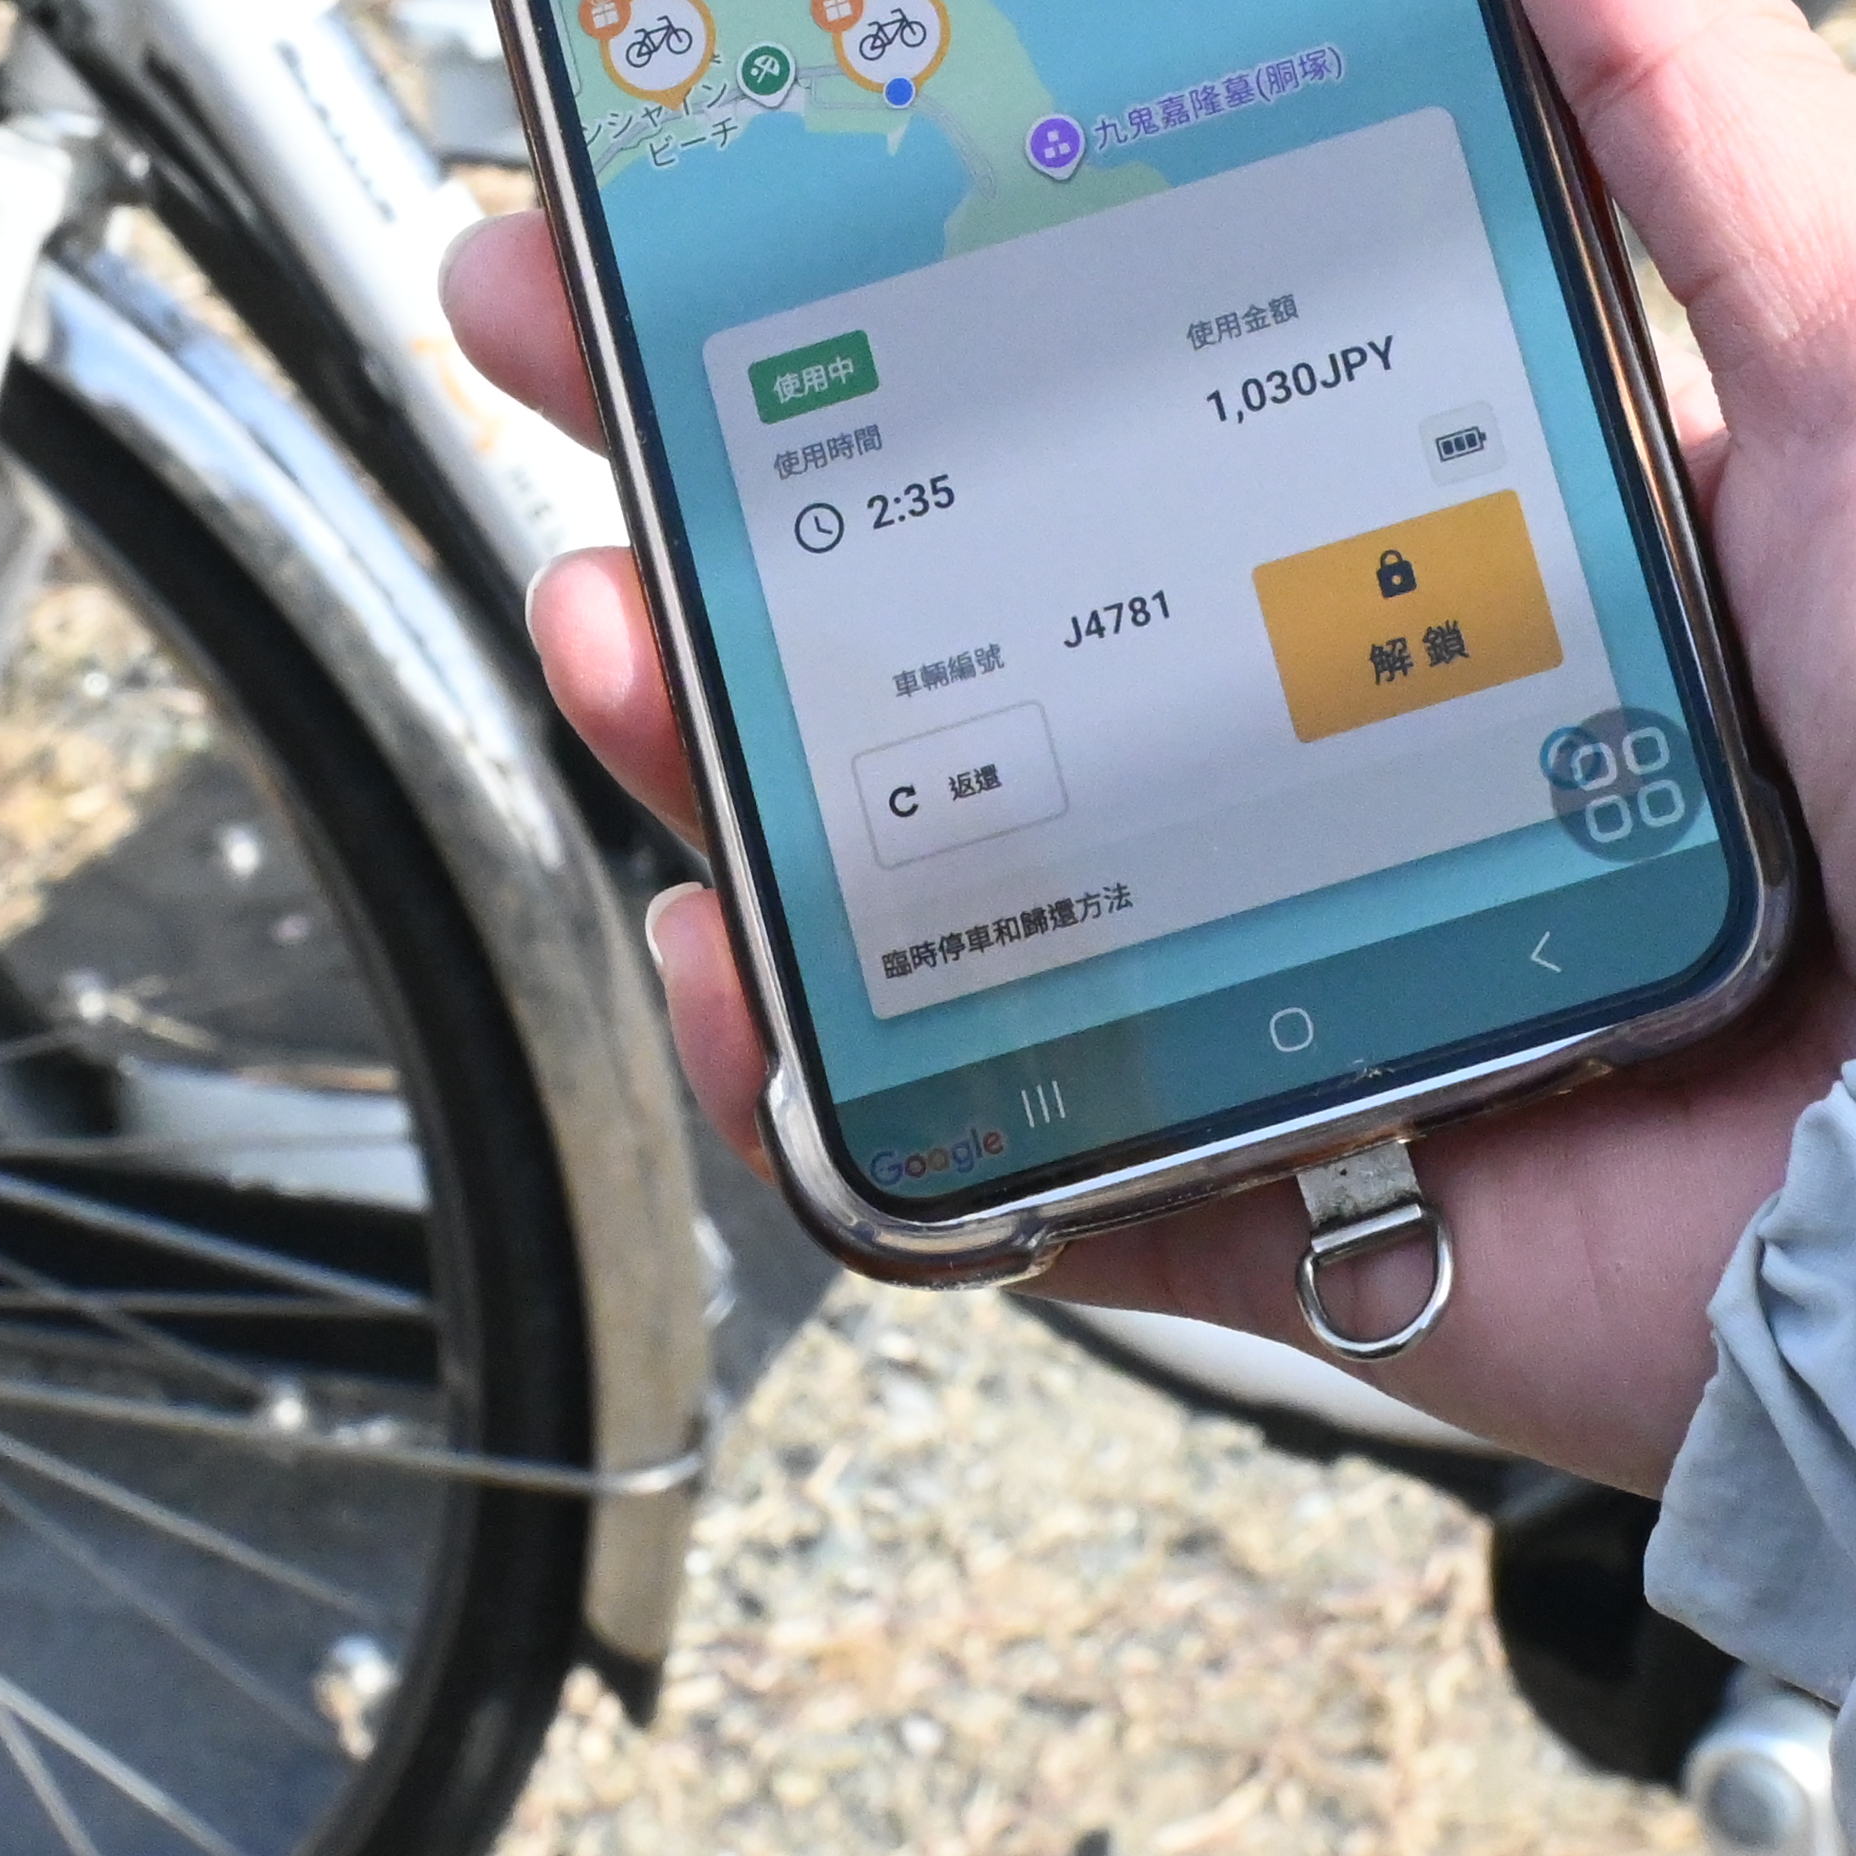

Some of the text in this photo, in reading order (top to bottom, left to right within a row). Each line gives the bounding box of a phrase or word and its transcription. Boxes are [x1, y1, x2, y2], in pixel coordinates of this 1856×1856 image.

[1093, 46, 1343, 151] 九鬼嘉隆墓(胴塚)
[648, 116, 739, 167] ビーチ
[1185, 292, 1300, 351] 使用金額
[772, 355, 855, 405] 使用中
[1205, 334, 1394, 424] 1,030JPY
[772, 423, 884, 481] 使用時間
[866, 473, 956, 530] 2:35
[1062, 589, 1171, 649] J4781
[947, 762, 1003, 802] 返還
[869, 1126, 1006, 1187] Google
